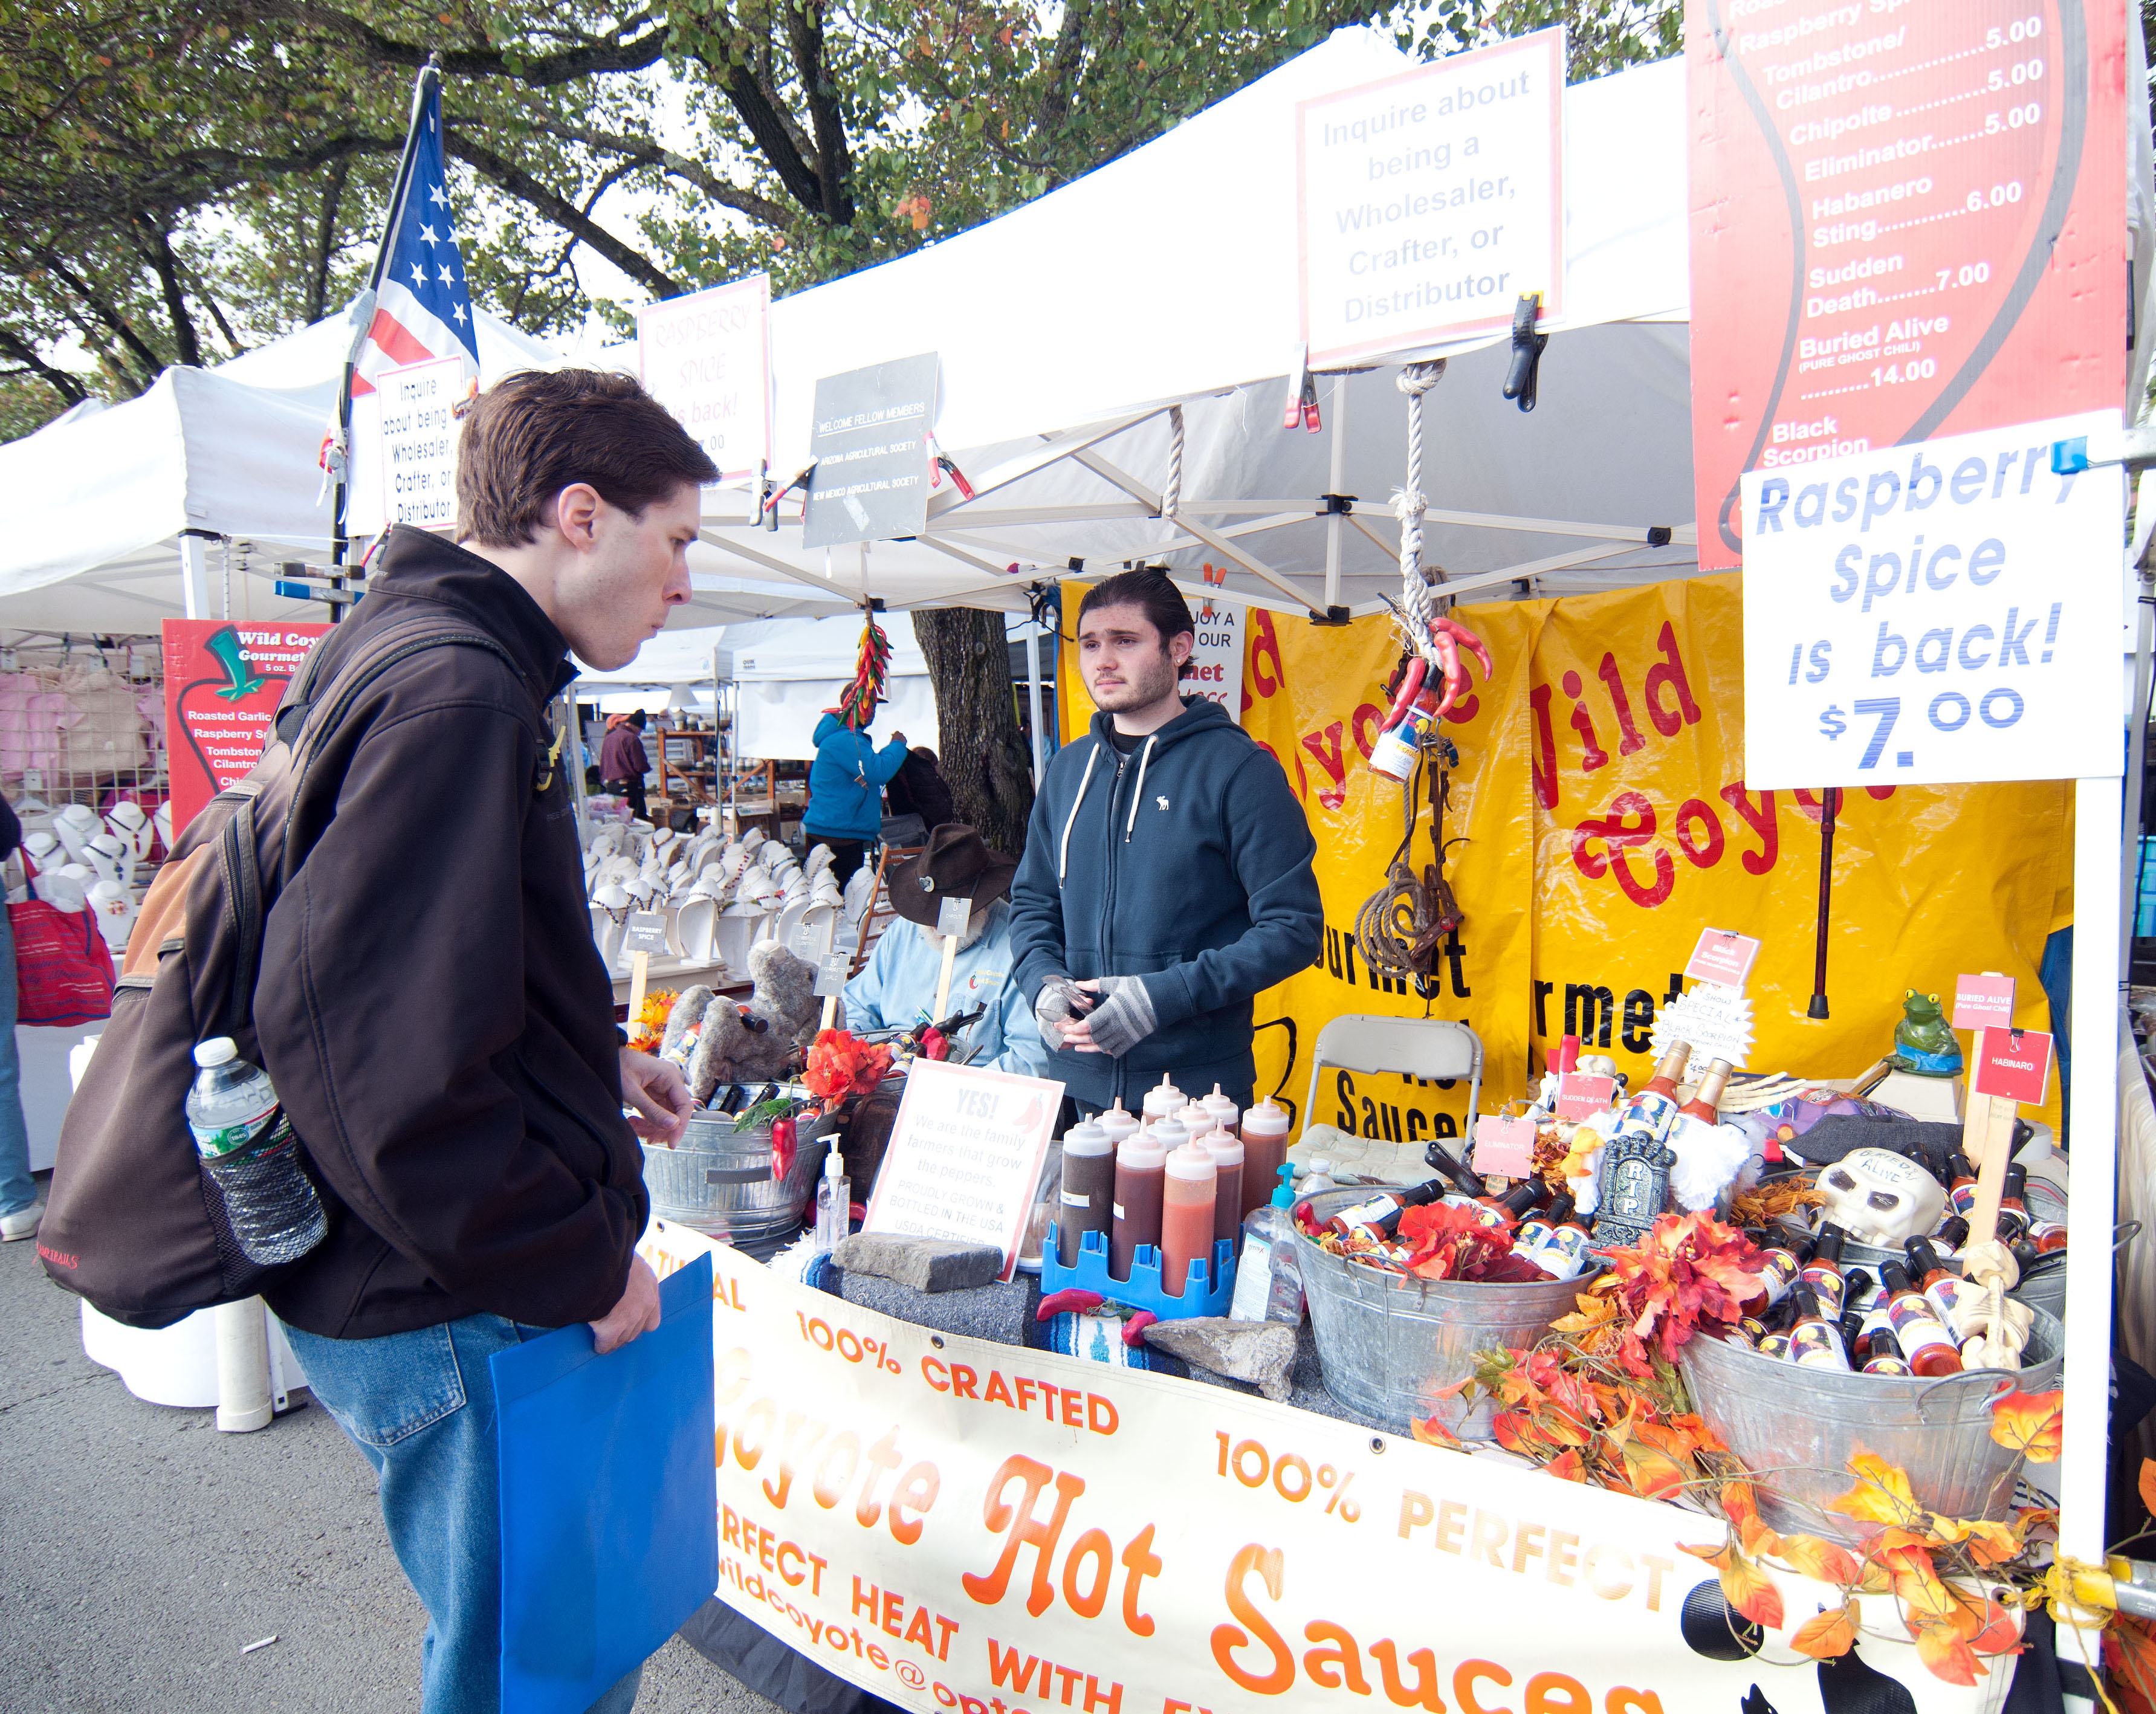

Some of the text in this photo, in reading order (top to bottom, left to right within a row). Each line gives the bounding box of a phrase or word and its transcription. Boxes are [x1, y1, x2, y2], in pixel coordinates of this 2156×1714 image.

[1739, 3, 1862, 54] Raspberry
[1762, 25, 1906, 85] Tombstone/
[1324, 70, 1530, 147] Inquire about
[1789, 103, 1892, 146] Chipolte
[1368, 136, 1480, 182] being a
[1804, 133, 1933, 181] Eliminator
[1335, 175, 1516, 233] Wholesaler,
[1811, 175, 1933, 220] Habanero
[1813, 218, 1877, 249] Sting
[1348, 225, 1504, 276] Crafter, or
[1810, 254, 1903, 289] Sudden
[1345, 271, 1510, 325] Distributor
[1807, 289, 1877, 319] Death
[655, 302, 751, 349] RASPBERRY
[1799, 315, 1949, 359] Buried Alive
[679, 352, 727, 389] SPICE
[1798, 340, 1921, 374] (PURE GHOST CHILI)
[400, 379, 437, 404] Inquire
[690, 392, 739, 424] back!
[383, 406, 447, 435] about being
[818, 401, 925, 434] WELCOME FELLOW MEMBERS
[1772, 416, 1837, 444] Black
[820, 454, 844, 466] ARIZONA
[889, 440, 918, 454] SOCIETY
[1763, 436, 1869, 468] Scorpion
[441, 470, 452, 486] or
[826, 487, 846, 499] MEXICO
[892, 475, 919, 488] SOCIETY
[397, 497, 451, 522] Distributor
[1830, 534, 2006, 613] Spice
[1224, 612, 1235, 626] A
[237, 632, 282, 646] Wild
[1198, 632, 1231, 647] OUR
[1870, 601, 2063, 679] back!
[265, 664, 271, 672] 5
[188, 711, 271, 722] Roasted Garlic
[193, 728, 253, 741] Raspberry
[631, 925, 662, 934] RASPBERRY
[1701, 951, 1740, 968] Scorpion
[1702, 992, 1732, 1006] SHOW
[1955, 993, 2012, 1004] BURIED ALIVE
[1991, 1056, 2034, 1072] HABINARO
[956, 1087, 1001, 1120] YES!
[1561, 1094, 1608, 1105] SUDDEN DEATH
[914, 1113, 1026, 1152] We are the family
[1483, 1139, 1525, 1151] ELIMINATOR
[907, 1133, 1023, 1171] farmers that grow
[916, 1158, 996, 1189] the peppers.
[897, 1179, 1004, 1215] PROUDLY GROWN &
[889, 1195, 1004, 1234] BOTTLED IN THE USA
[894, 1218, 925, 1239] USDA
[796, 1309, 1119, 1436] 100% CRAFTED
[1216, 1429, 1674, 1612] 100% PERFECT
[962, 1453, 1163, 1637] Hot
[852, 1576, 959, 1663] HEAT
[988, 1637, 1124, 1714] WITH
